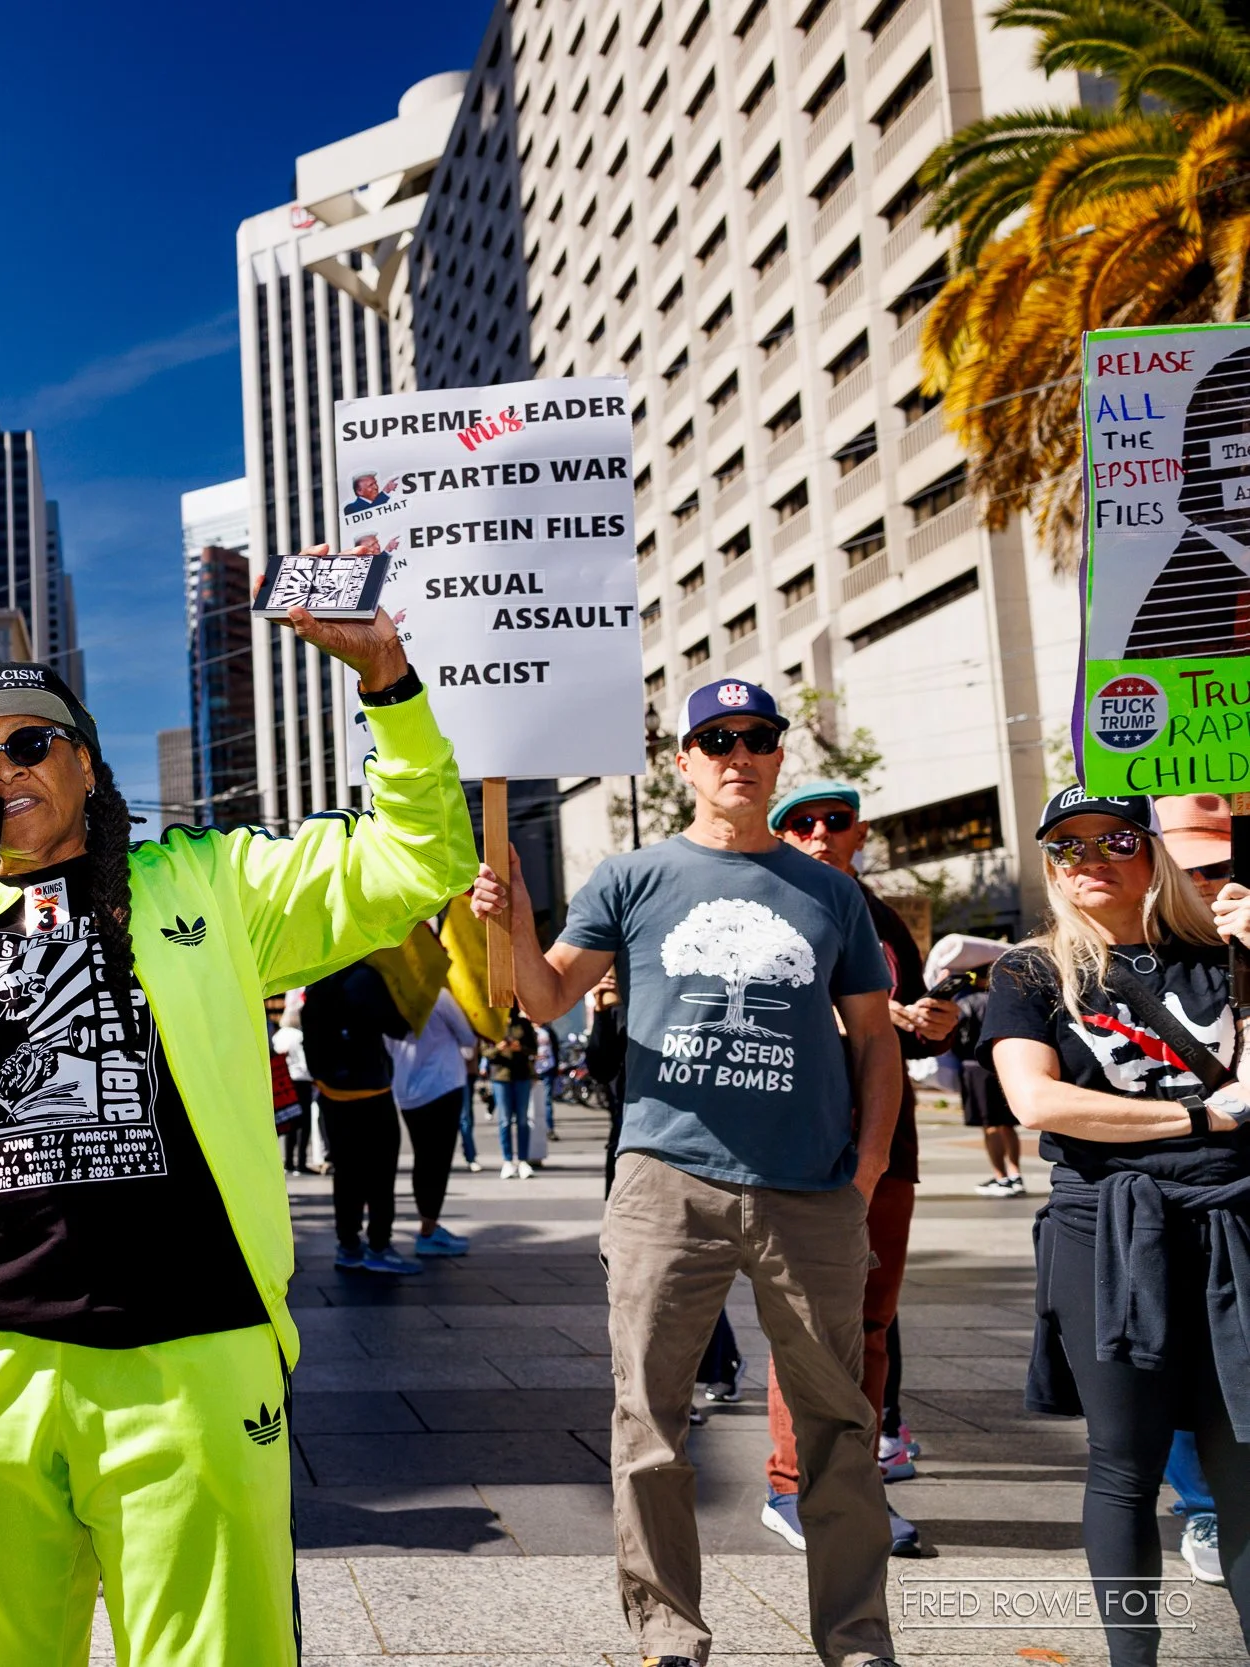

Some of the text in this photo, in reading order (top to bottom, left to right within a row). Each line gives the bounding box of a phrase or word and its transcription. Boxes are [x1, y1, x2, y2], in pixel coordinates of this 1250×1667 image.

[1097, 350, 1195, 377] RELASE
[1096, 393, 1166, 424] ALL
[342, 409, 482, 442] SUPREME
[1101, 431, 1154, 450] THE
[401, 456, 628, 495] STARTED WAR
[1093, 456, 1190, 489] EPSTEIN
[345, 499, 408, 526] I DID THAT
[1097, 500, 1164, 529] FILES
[410, 514, 625, 549] EPSTEIN FILES
[426, 572, 543, 600] SEXUAL
[492, 605, 634, 630] ASSAULT
[439, 661, 550, 687] RACIST
[1101, 698, 1155, 715] FUCK
[1100, 715, 1155, 730] TRUMP
[1126, 752, 1250, 791] CHILD
[42, 882, 63, 895] KINGS
[661, 1033, 795, 1069] DROP SEEDS
[101, 1050, 146, 1122] Here
[657, 1061, 794, 1092] NOT BOMBS
[2, 1138, 34, 1153] JUNE
[73, 1130, 118, 1143] MARCH
[125, 1128, 153, 1140] 10AM
[24, 1149, 63, 1162] DANCE
[70, 1144, 106, 1157] STAGE
[114, 1142, 147, 1153] NOON
[28, 1160, 66, 1172] PLAZA
[92, 1154, 141, 1166] MARKET
[147, 1152, 159, 1161] ST
[17, 1172, 54, 1187] CENTER
[71, 1168, 82, 1180] SF
[88, 1166, 115, 1178] 2026
